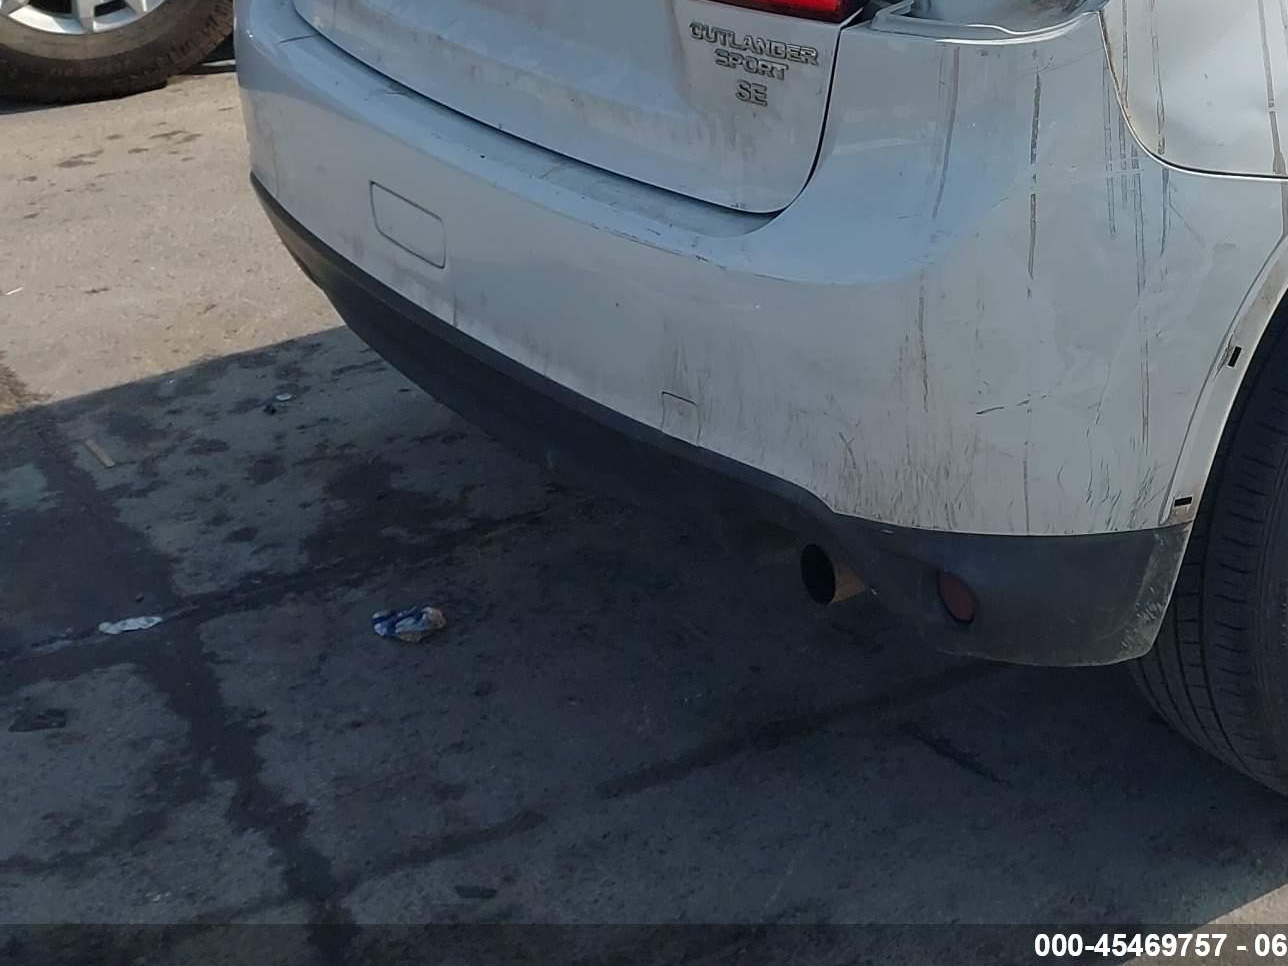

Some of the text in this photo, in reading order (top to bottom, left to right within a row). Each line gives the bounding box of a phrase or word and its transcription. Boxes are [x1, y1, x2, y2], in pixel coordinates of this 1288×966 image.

[689, 21, 820, 66] OUTLANDER
[714, 48, 790, 81] SPORT
[735, 79, 768, 107] SE
